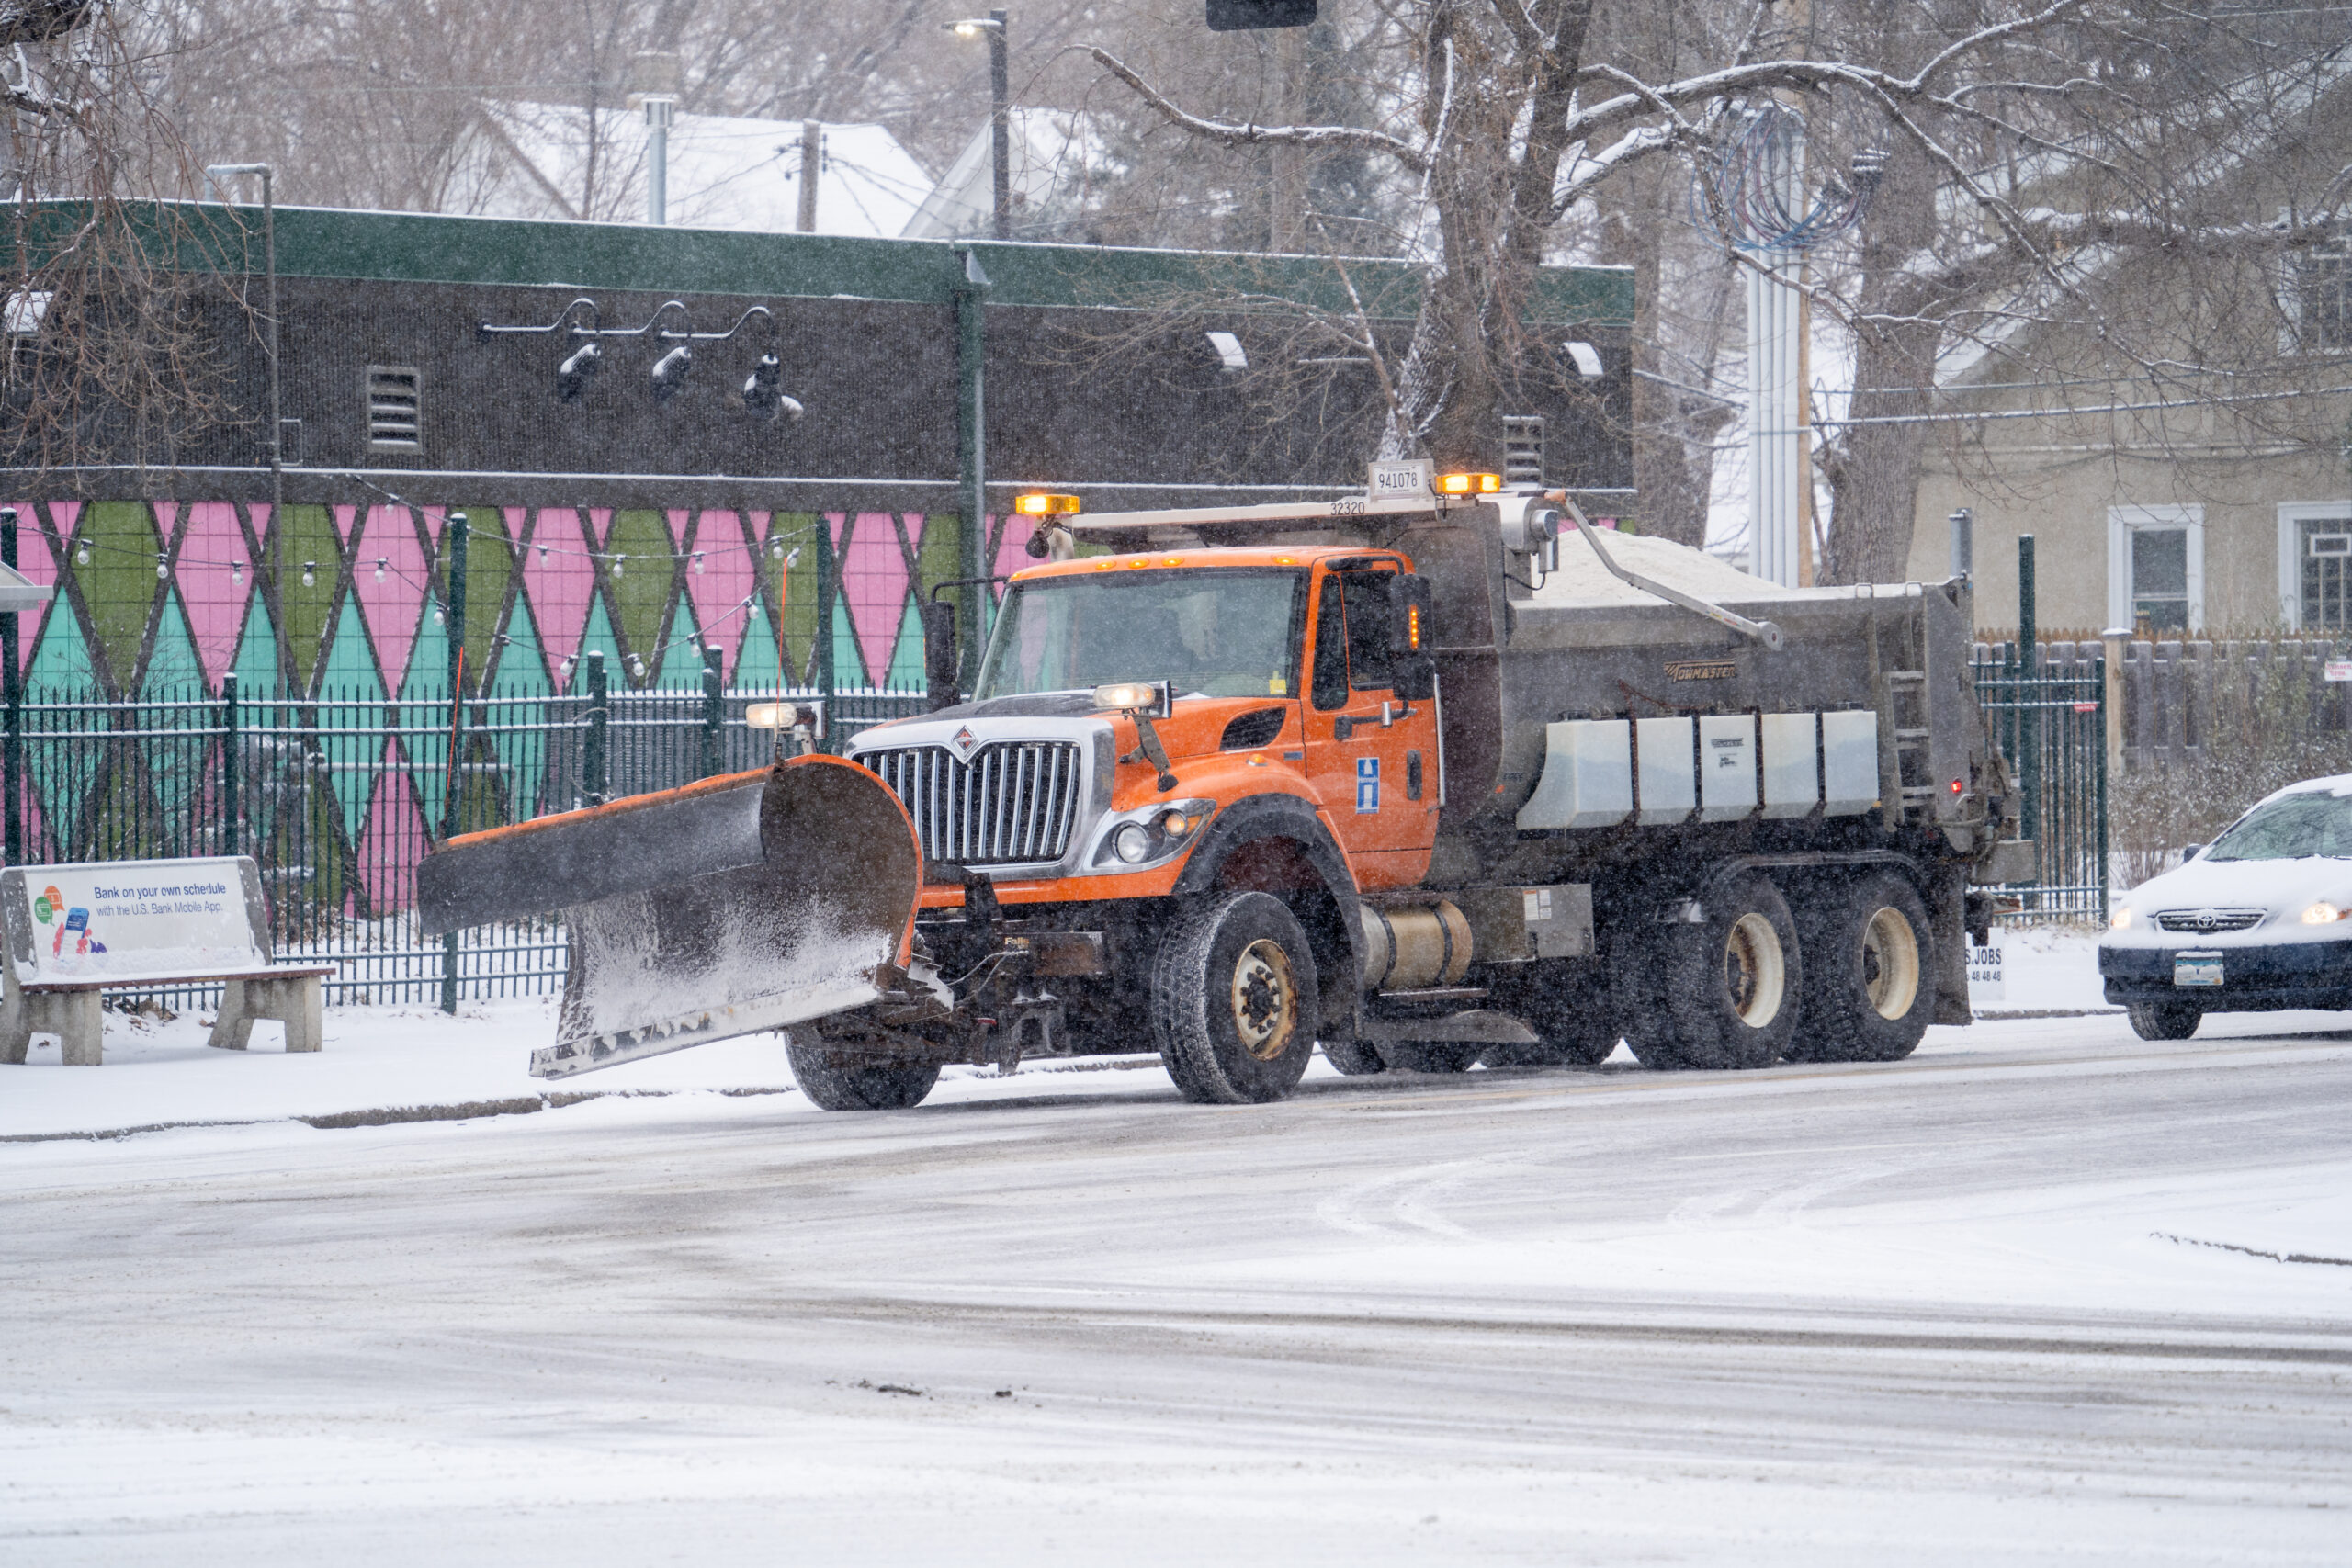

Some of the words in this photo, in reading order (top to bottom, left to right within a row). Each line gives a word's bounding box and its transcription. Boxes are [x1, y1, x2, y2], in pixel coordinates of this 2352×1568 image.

[1378, 472, 1418, 489] 941078
[1330, 502, 1365, 516] 32320
[94, 886, 120, 899] Bank
[122, 887, 135, 898] on
[136, 886, 158, 900] your
[161, 886, 181, 897] own
[183, 882, 226, 896] schedule
[96, 905, 115, 917] with
[116, 904, 130, 916] the
[131, 903, 149, 915] U.S.
[151, 901, 173, 915] Bank
[175, 900, 202, 913] Mobile
[204, 900, 223, 914] App.
[1004, 936, 1029, 945] Falls
